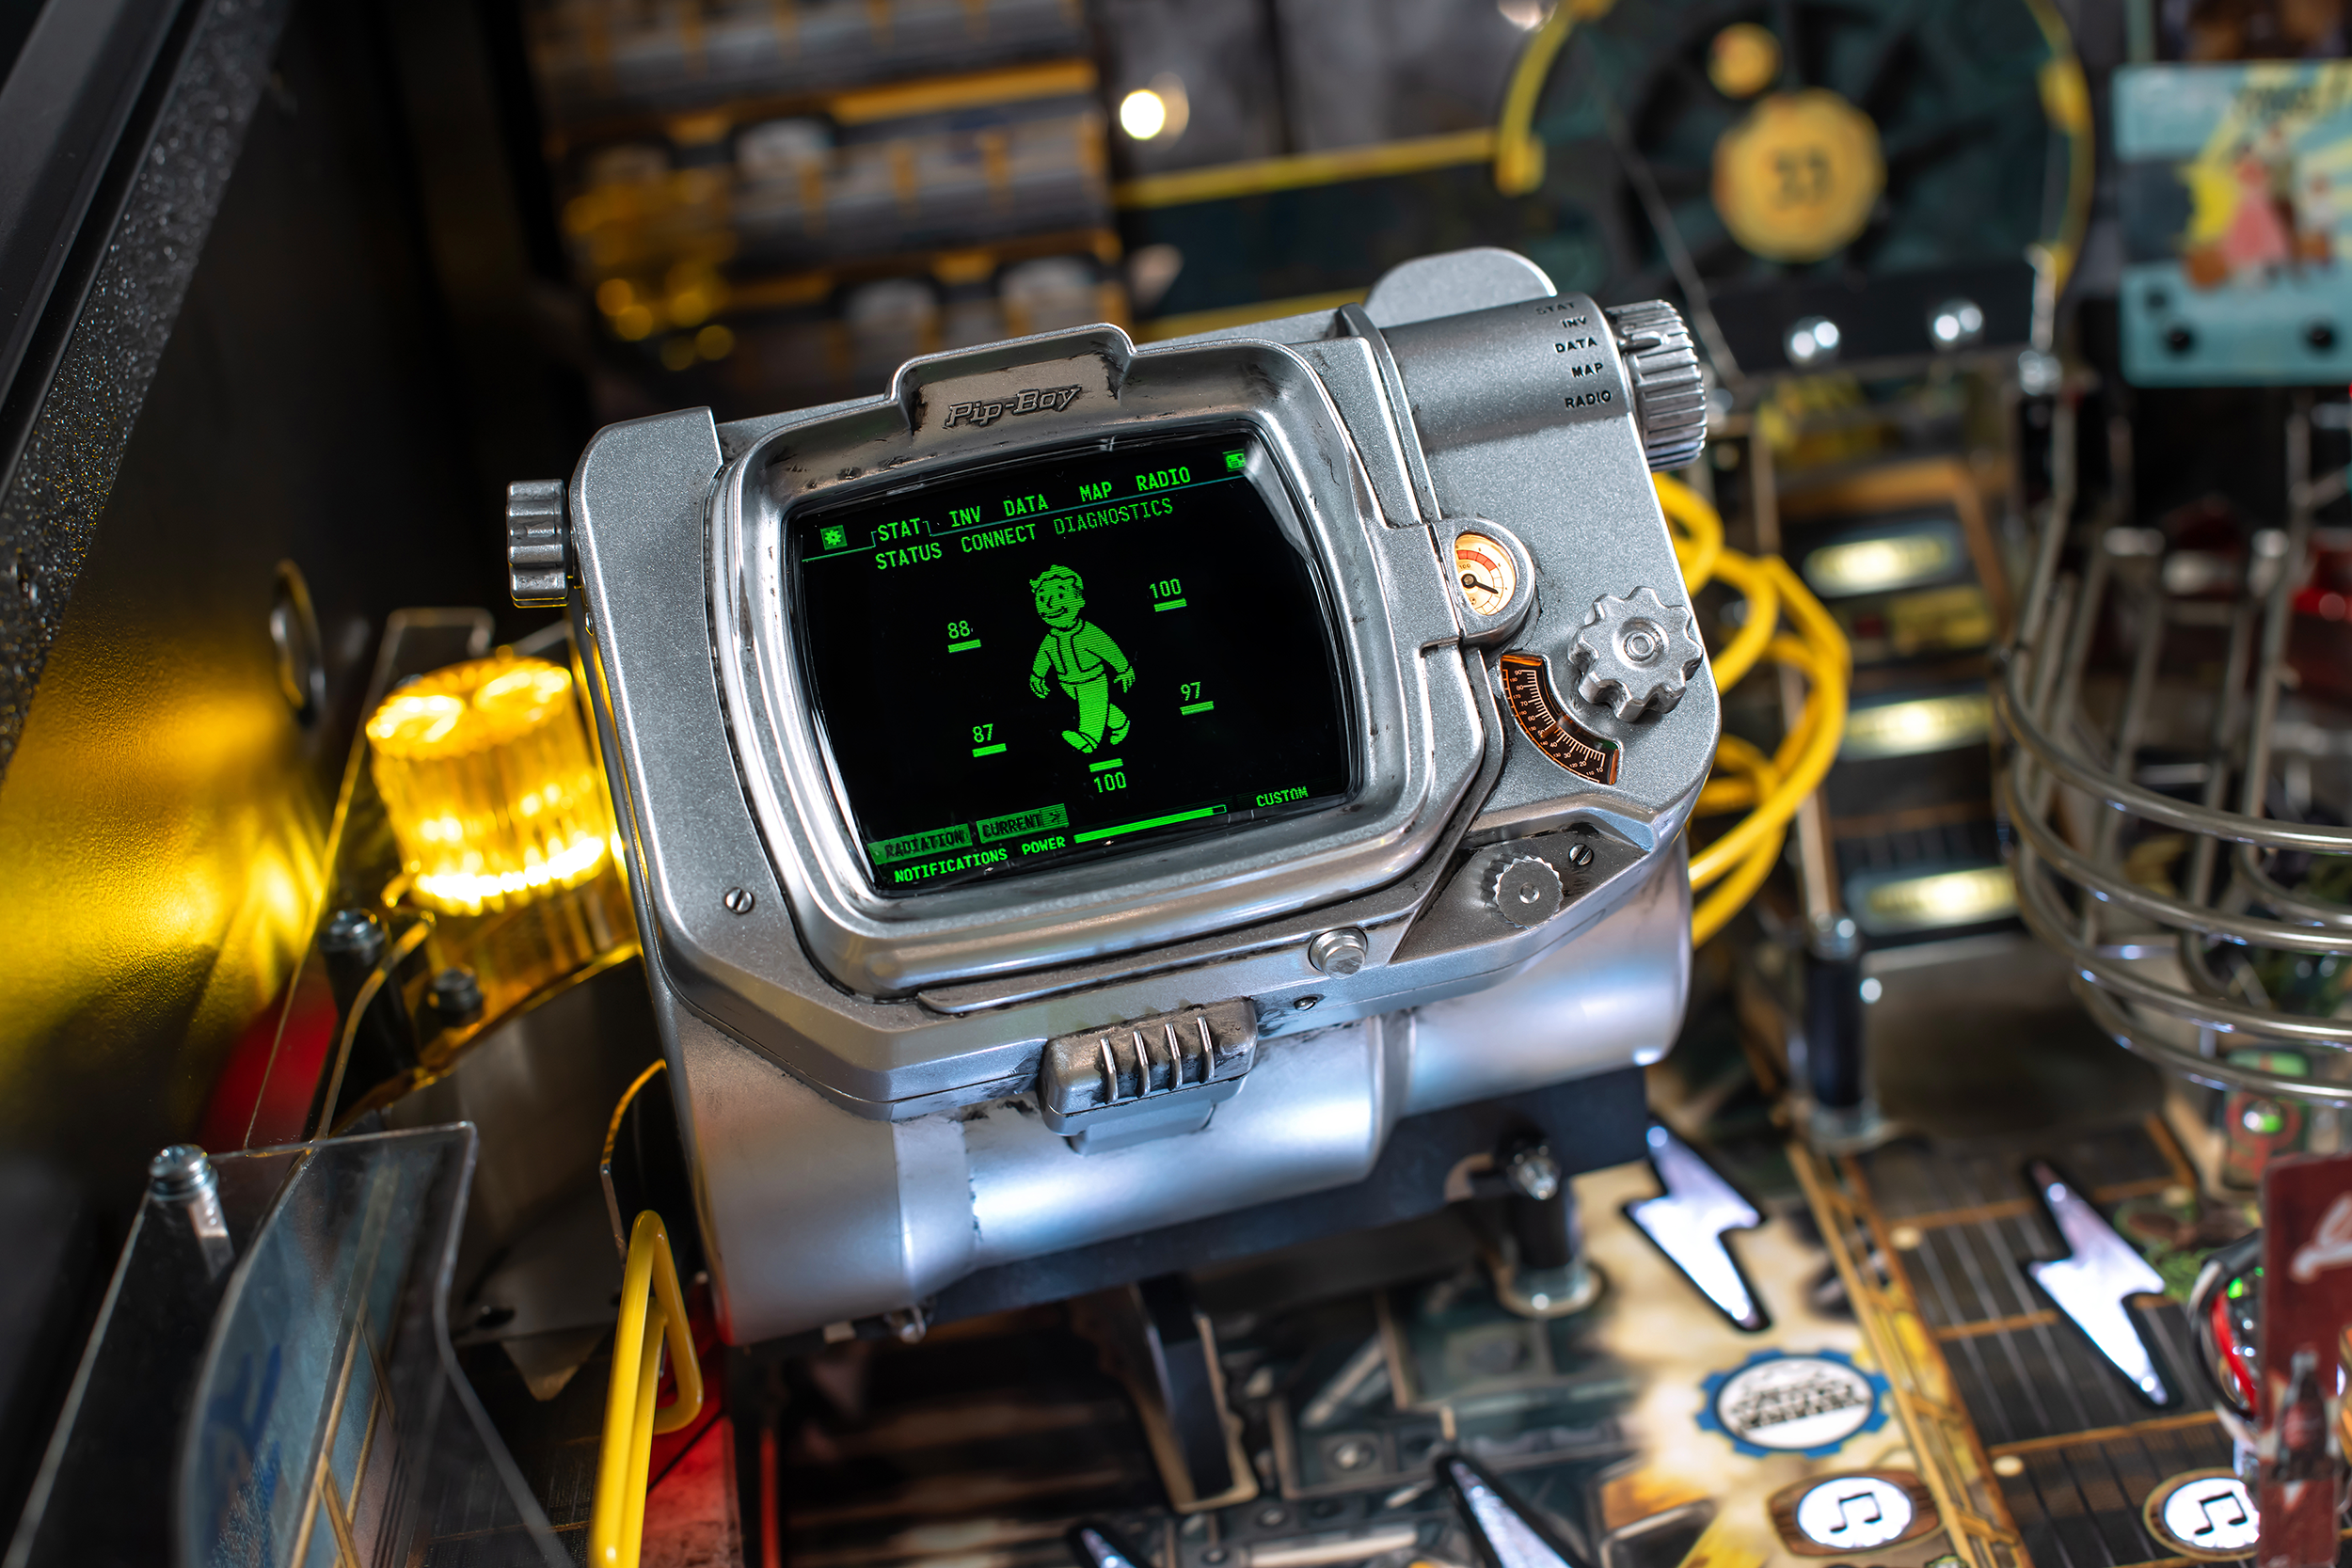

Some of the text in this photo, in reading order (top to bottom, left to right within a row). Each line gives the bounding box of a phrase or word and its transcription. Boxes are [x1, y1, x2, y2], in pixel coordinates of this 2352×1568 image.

[1535, 302, 1575, 315] STAT
[1562, 316, 1587, 328] INV
[1554, 337, 1597, 354] DATA
[1571, 362, 1603, 378] MAP
[945, 385, 1083, 427] Pip-Boy
[1565, 389, 1612, 408] RADIO
[877, 466, 1191, 542] STAT INV DATA MAP RADIO
[875, 498, 1174, 570] STATUS CONNECT DIAGNOSTICS
[1149, 578, 1183, 599] 100
[946, 621, 971, 639] 88
[1180, 682, 1202, 701] 97
[972, 723, 994, 743] 87
[1093, 770, 1127, 793] 100
[1255, 785, 1309, 807] CUSTOM
[884, 811, 1043, 859] RADIATION CURRENT
[893, 835, 1066, 883] NOTIFICATIONS POWER
